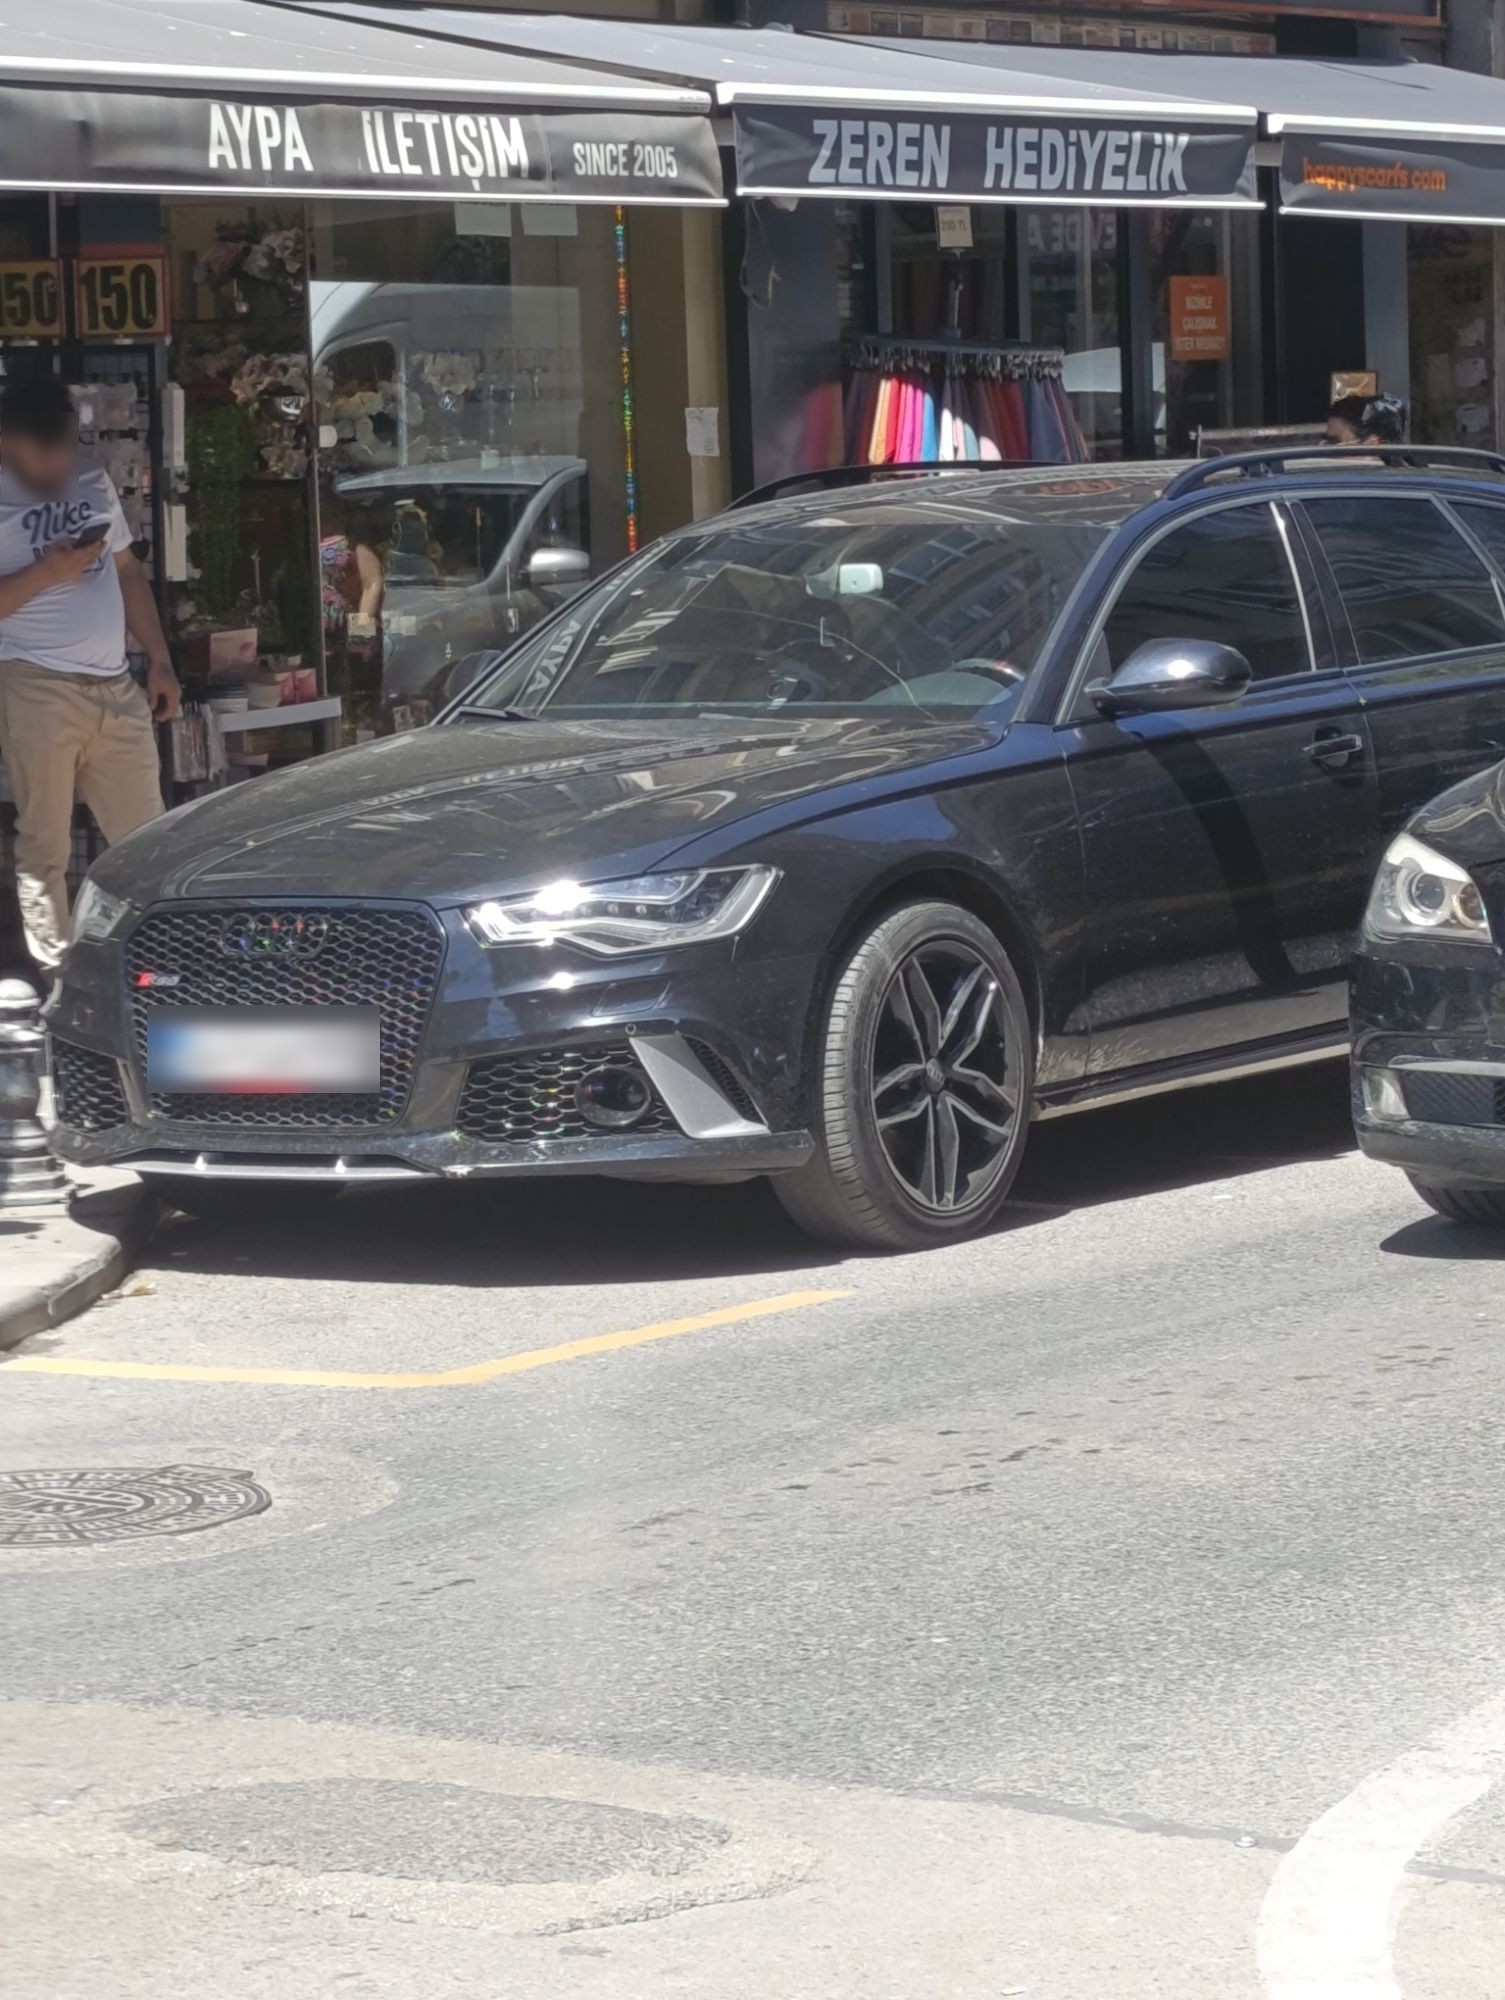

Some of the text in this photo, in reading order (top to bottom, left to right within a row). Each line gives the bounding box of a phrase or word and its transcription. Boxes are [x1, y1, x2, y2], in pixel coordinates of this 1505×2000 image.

[208, 103, 315, 172] AYPA
[573, 142, 679, 178] SINCE 2005
[808, 118, 951, 189] ZEREN
[0, 270, 58, 327] 50
[80, 263, 157, 331] 150
[22, 500, 91, 545] Nike
